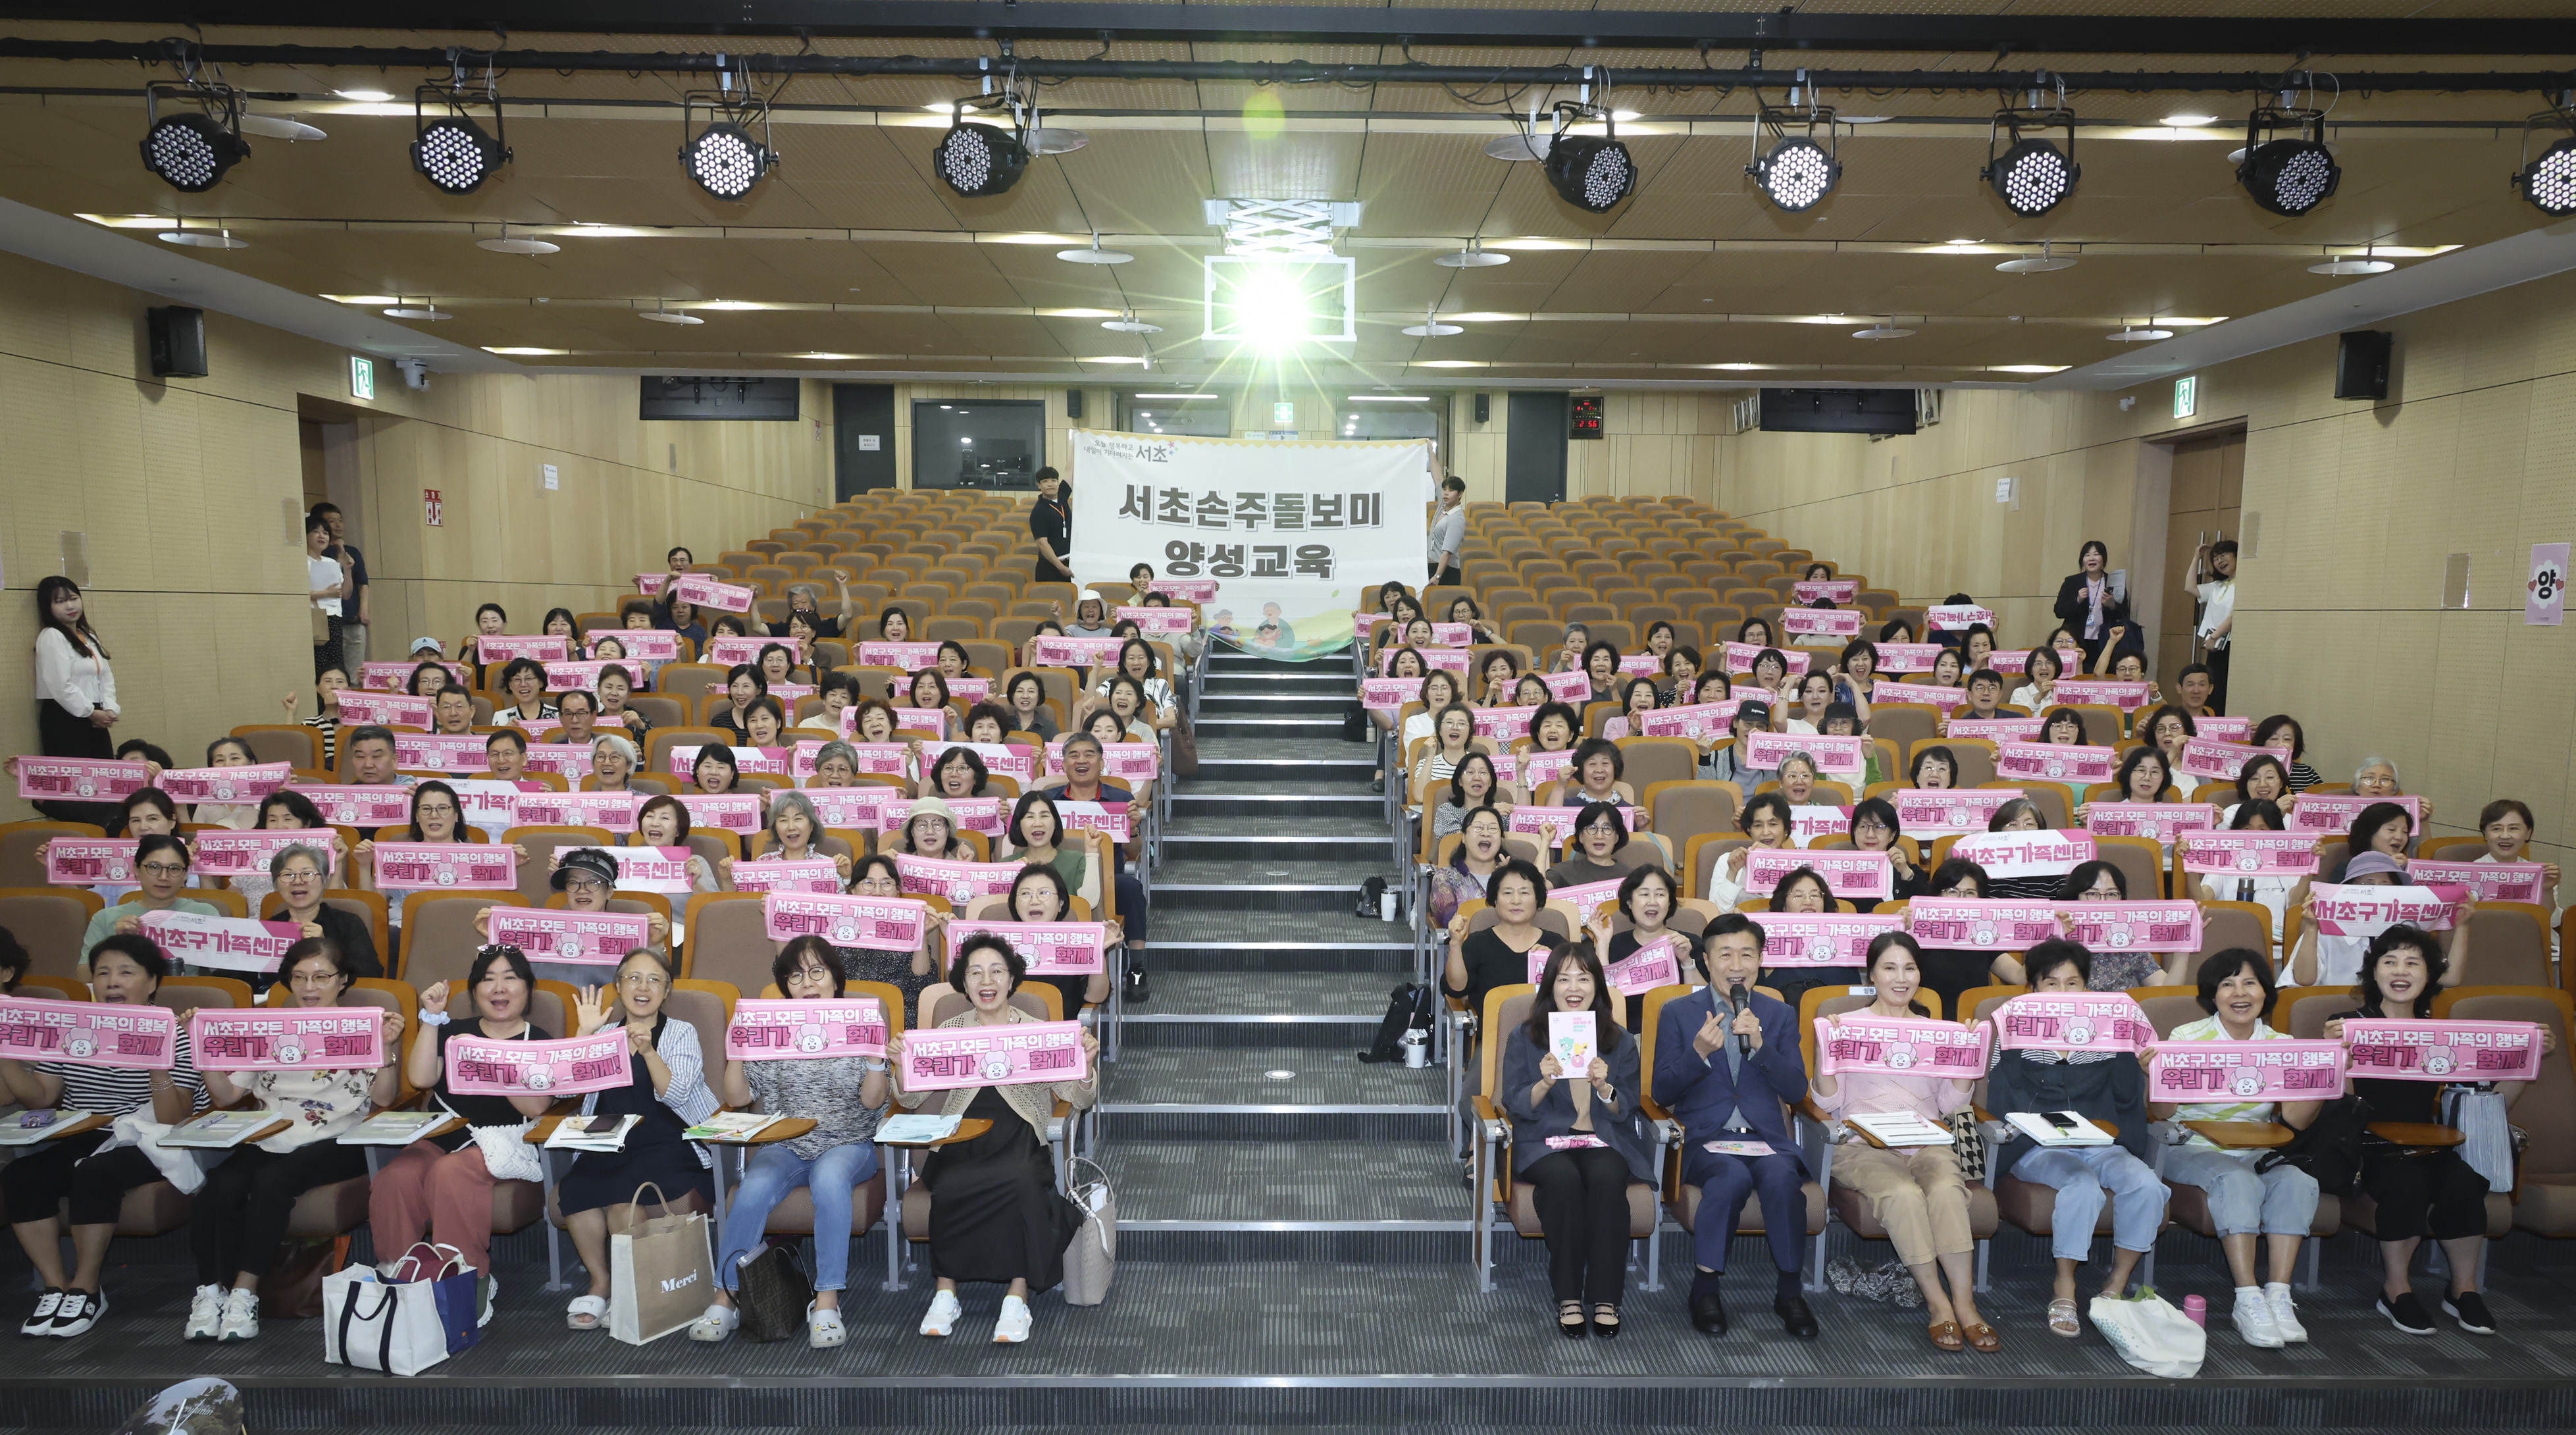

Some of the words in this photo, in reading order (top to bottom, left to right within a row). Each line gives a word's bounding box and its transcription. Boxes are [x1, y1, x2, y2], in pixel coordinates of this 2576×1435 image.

[1084, 446, 1102, 455] 내일이
[1104, 449, 1134, 460] 기다려지는
[1136, 445, 1168, 462] 서초
[1109, 442, 1134, 450] 행복하고
[1119, 484, 1381, 529] 서초손주돌보미
[1165, 540, 1332, 579] 양성교육
[2538, 569, 2556, 600] 양
[1368, 692, 1400, 703] 우리가
[1755, 740, 1781, 750] 서초구
[1783, 741, 1802, 750] 모든
[1808, 742, 1834, 752] 가족의
[1836, 743, 1853, 752] 행복
[2005, 746, 2034, 758] 서초구
[2037, 749, 2055, 760] 모든
[2061, 750, 2089, 762] 가족의
[2092, 753, 2110, 763] 행복
[1824, 753, 1852, 766] 함께!
[2004, 757, 2044, 772] 우리가
[2076, 763, 2107, 777] 함께!
[28, 765, 58, 777] 서초구
[61, 766, 82, 777] 모든
[88, 767, 118, 779] 가족의
[122, 769, 144, 779] 행복
[518, 796, 547, 808] 서초구
[550, 798, 573, 808] 모든
[580, 798, 608, 809] 가족의
[611, 798, 631, 810] 행복
[519, 807, 559, 823] 우리가
[600, 809, 631, 825] 함께!
[383, 851, 416, 864] 서초구
[419, 851, 442, 864] 모든
[447, 851, 480, 864] 가족의
[483, 852, 506, 864] 행복
[1961, 842, 2090, 864] 서초구가족센터
[384, 864, 430, 881] 우리가
[471, 866, 506, 881] 함께!
[1755, 857, 1788, 870] 서초구
[1822, 859, 1853, 872] 가족의
[1856, 859, 1878, 872] 행복
[1842, 873, 1878, 889] 함께!
[2413, 868, 2445, 882] 서초구
[2448, 870, 2471, 883] 모든
[2479, 871, 2510, 883] 가족의
[2512, 871, 2535, 883] 행복
[774, 901, 815, 916] 서초구
[817, 904, 844, 918] 모든
[849, 904, 889, 920] 가족의
[891, 907, 916, 922] 행복
[1915, 906, 1953, 921] 서초구
[1955, 908, 1982, 921] 모든
[1988, 908, 2027, 922] 가족의
[2029, 908, 2055, 922] 행복
[499, 918, 538, 931] 서초구
[540, 921, 566, 934] 모든
[573, 920, 610, 935] 가족의
[613, 923, 638, 937] 행복
[774, 914, 828, 934] 우리가
[875, 921, 915, 941] 함께!
[1915, 920, 1967, 939] 우리가
[2014, 923, 2053, 941] 함께!
[147, 927, 295, 957] 서초구가족센터
[732, 1010, 772, 1026] 서초구
[775, 1010, 806, 1025] 모든
[818, 1008, 861, 1024] 가족의
[862, 1008, 885, 1025] 행
[2002, 1001, 2042, 1017] 서초구
[2045, 1002, 2075, 1016] 모든
[2082, 1003, 2128, 1018] 가족의
[43, 1013, 76, 1028] 모든
[86, 1014, 134, 1032] 가족의
[138, 1018, 168, 1034] 행복
[204, 1020, 249, 1036] 서초구
[252, 1021, 284, 1035] 모든
[292, 1019, 337, 1034] 가족의
[341, 1018, 371, 1033] 행복
[2006, 1016, 2059, 1038] 우리가
[117, 1033, 163, 1057] 함께!
[731, 1026, 790, 1048] 우리가
[912, 1041, 958, 1058] 서초구
[960, 1039, 991, 1056] 모든
[998, 1036, 1043, 1053] 가족의
[1044, 1032, 1075, 1049] 행복
[1827, 1027, 1867, 1042] 서초구
[1870, 1028, 1898, 1043] 모든
[1906, 1029, 1950, 1045] 가족의
[1953, 1031, 1981, 1046] 행복
[2354, 1030, 2400, 1047] 서초구
[2403, 1031, 2434, 1047] 모든
[2443, 1031, 2492, 1048] 가족의
[2496, 1032, 2529, 1049] 행복
[204, 1036, 267, 1058] 우리가
[324, 1035, 371, 1057] 함께!
[457, 1045, 502, 1063] 서초구
[504, 1049, 536, 1064] 모든
[546, 1046, 586, 1065] 가족의
[588, 1043, 617, 1060] 행복
[1828, 1040, 1881, 1061] 우리가
[1935, 1047, 1979, 1068] 함께!
[912, 1055, 975, 1077] 우리가
[1029, 1049, 1075, 1071] 함께!
[2161, 1052, 2206, 1068] 서초구
[2209, 1053, 2242, 1068] 모든
[2250, 1051, 2298, 1067] 가족의
[2301, 1051, 2334, 1066] 행복
[2352, 1045, 2417, 1068] 우리가
[2475, 1049, 2527, 1070] 함께!
[458, 1061, 518, 1084] 우리가
[571, 1056, 623, 1082] 함께!
[2161, 1067, 2225, 1089] 우리가
[2283, 1067, 2334, 1089] 함께!
[661, 1269, 697, 1293] Merci
